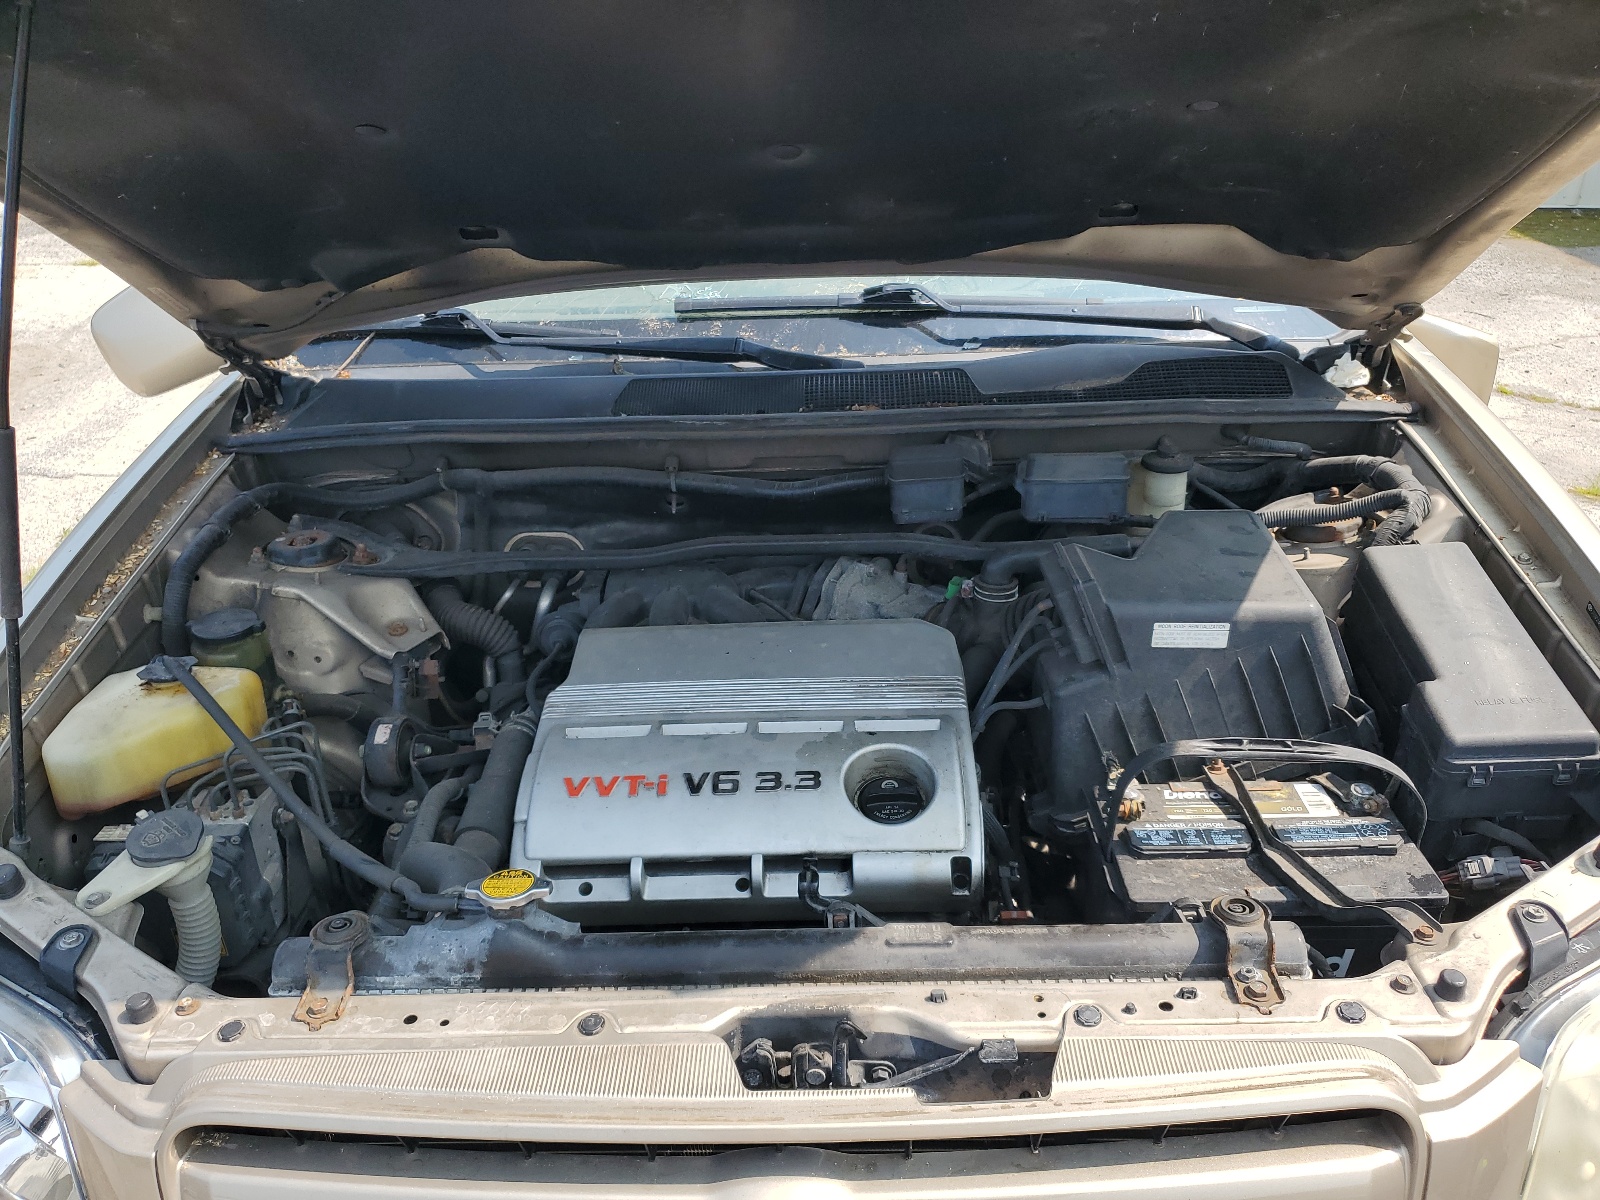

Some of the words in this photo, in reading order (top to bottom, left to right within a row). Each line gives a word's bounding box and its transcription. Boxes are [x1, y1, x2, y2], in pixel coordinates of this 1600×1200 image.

[563, 773, 669, 798] VVT-i
[683, 770, 741, 797] V6
[754, 770, 823, 793] 3.3
